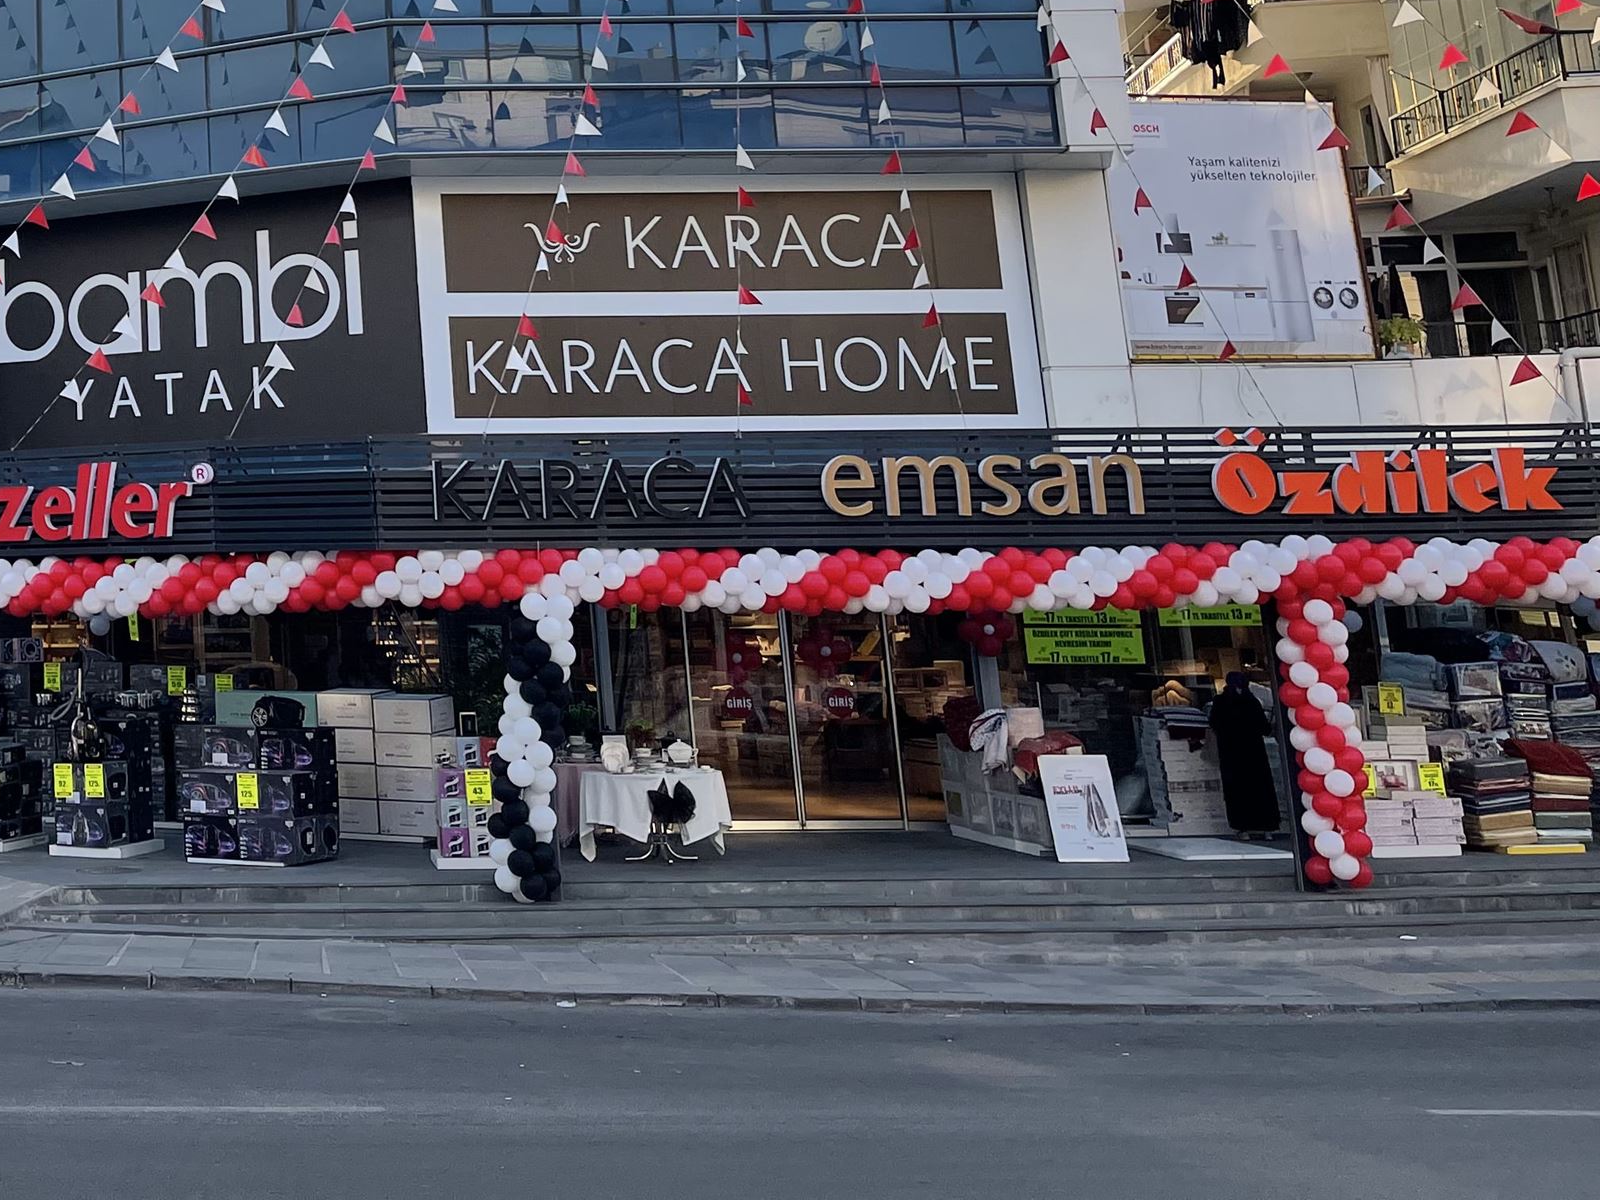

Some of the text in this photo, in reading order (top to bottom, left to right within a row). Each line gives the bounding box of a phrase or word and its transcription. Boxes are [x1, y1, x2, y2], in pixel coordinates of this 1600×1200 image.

[1133, 124, 1160, 133] OSCH
[1187, 156, 1281, 170] Yaşam kalitenizi
[1190, 170, 1246, 182] yükselten
[623, 213, 919, 269] KARACA
[465, 336, 999, 395] KARACA HOME
[63, 366, 285, 421] YATAK
[431, 456, 750, 521] KARACA
[821, 454, 1146, 517] emsan
[1211, 427, 1564, 515] Özdilek
[726, 697, 752, 710] GİRİŞ
[828, 696, 854, 709] GİRİŞ
